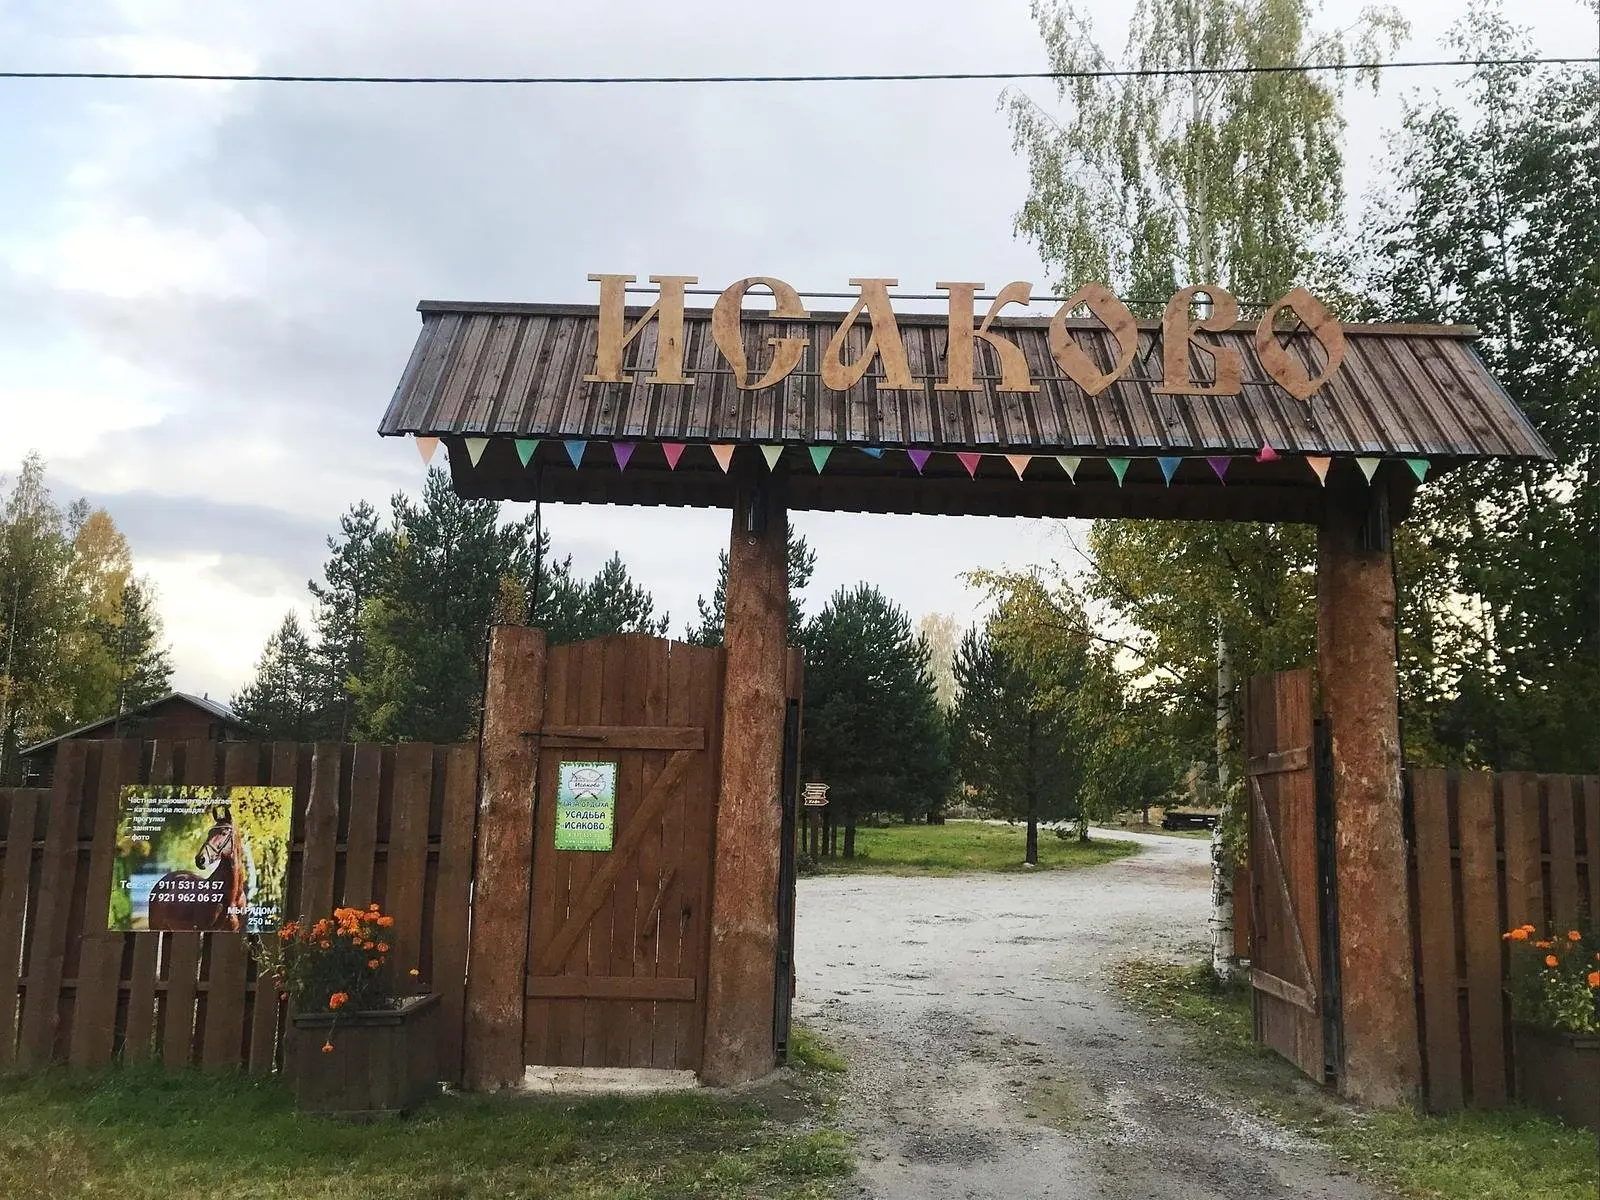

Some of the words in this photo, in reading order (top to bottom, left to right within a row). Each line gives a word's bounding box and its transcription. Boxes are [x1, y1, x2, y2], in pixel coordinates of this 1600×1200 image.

[584, 273, 1345, 401] ИСАКОВО
[128, 796, 157, 804] Частная
[173, 807, 205, 815] лошадях
[565, 811, 606, 820] УСАДЬБА
[133, 815, 166, 824] прогулки
[131, 833, 150, 842] фото
[158, 880, 175, 890] 911
[178, 880, 195, 890] 531
[198, 880, 210, 890] 54
[211, 880, 224, 890] 57
[158, 893, 175, 902] 921
[178, 893, 195, 902] 962
[197, 893, 210, 903] 06
[211, 893, 224, 903] 37
[227, 906, 243, 915] МЫ
[247, 917, 263, 926] 250
